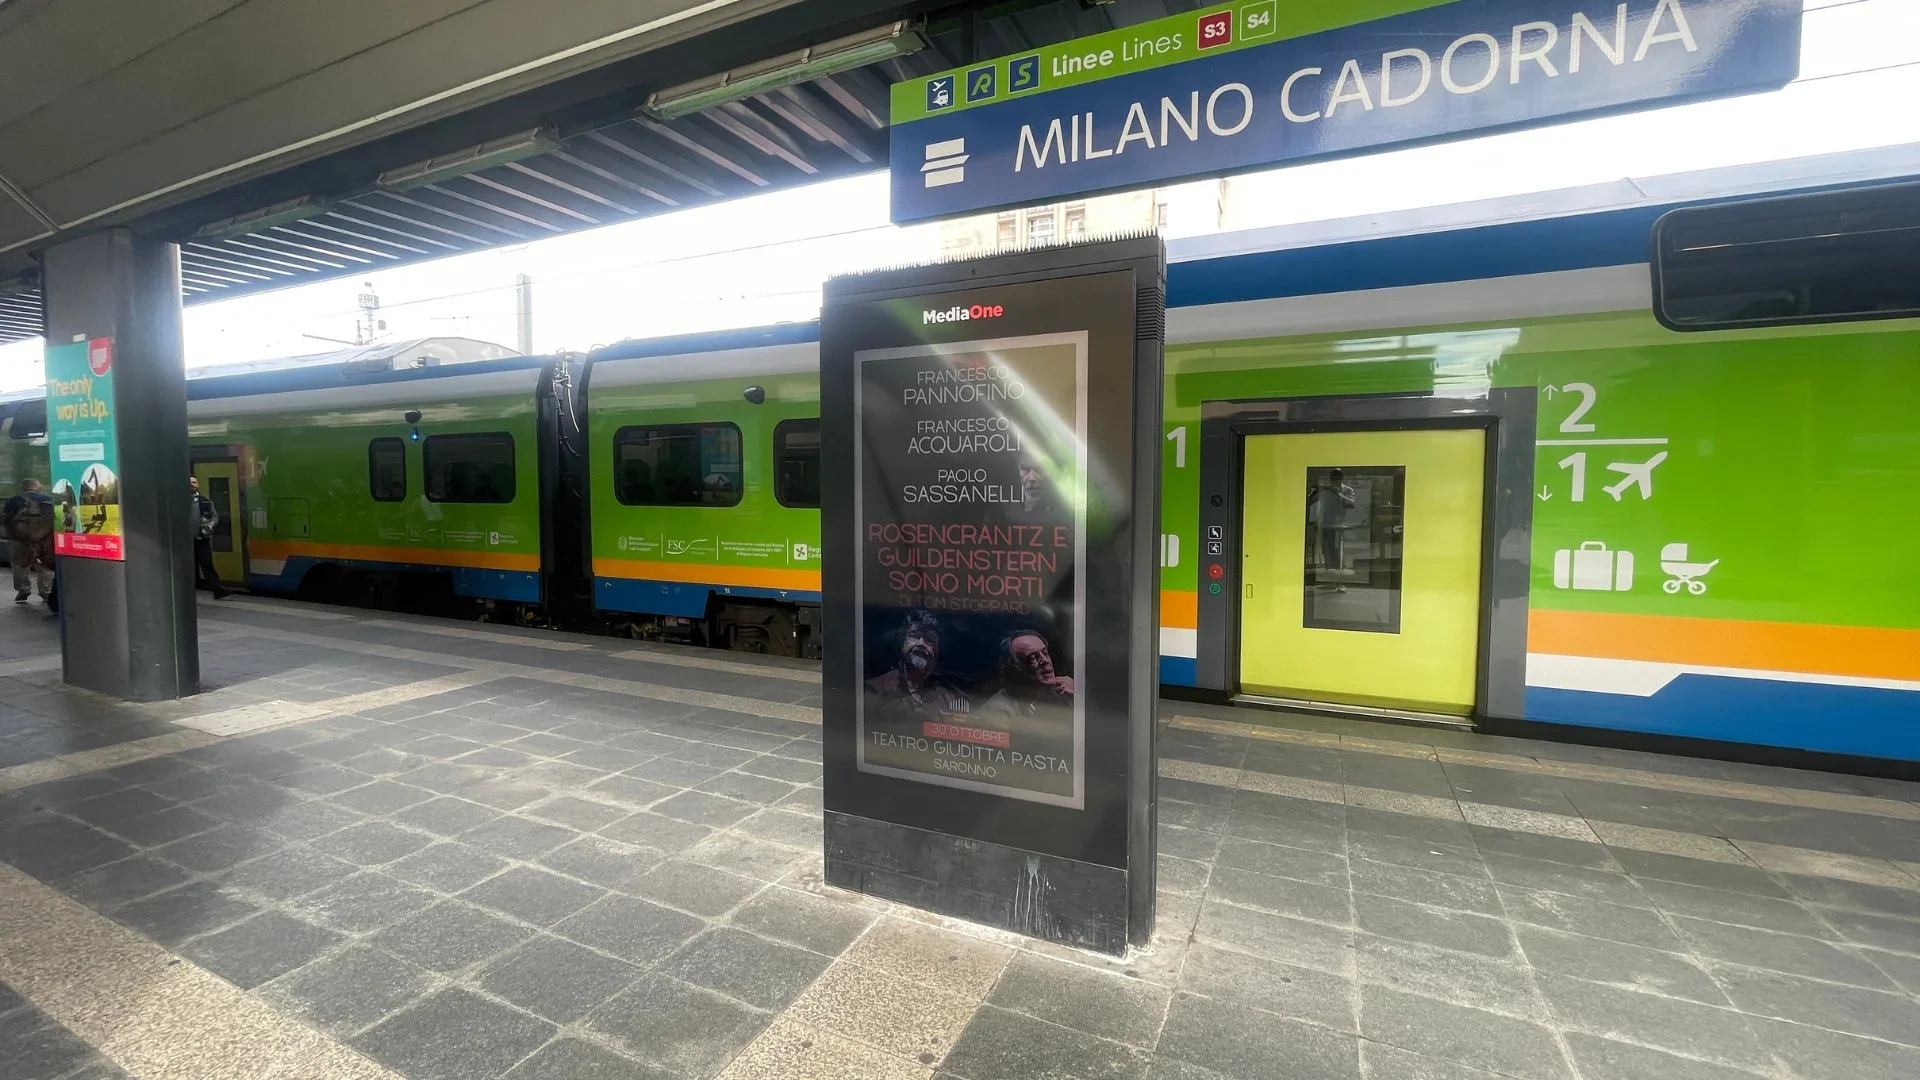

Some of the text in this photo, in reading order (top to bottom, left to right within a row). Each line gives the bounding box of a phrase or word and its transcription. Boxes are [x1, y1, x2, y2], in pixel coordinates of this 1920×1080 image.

[1052, 48, 1113, 77] Linee
[1122, 31, 1182, 62] Lines
[1204, 22, 1226, 38] S3
[1247, 11, 1270, 28] S4
[1014, 0, 1698, 172] MILANO CADORNA
[923, 304, 1003, 324] MediaOne
[70, 374, 93, 399] only
[917, 365, 1009, 384] FRANCESCO
[904, 381, 1024, 405] PANNOFINO
[56, 403, 78, 425] way
[1560, 382, 1596, 433] 2
[917, 416, 1009, 434] FRANCESCO
[908, 433, 1020, 454] ACQUAROLI
[1166, 426, 1186, 468] 1
[938, 468, 987, 483] PAOLO
[1558, 452, 1586, 502] 1
[903, 485, 1024, 503] SASSANELLI
[667, 540, 685, 551] FSC
[869, 523, 1068, 548] ROSENCRANTZ E
[878, 547, 1056, 572] GUILDENSTERN
[889, 570, 1043, 598] SONO MORTI
[931, 723, 1005, 743] 30 OTTOBRE
[871, 731, 1069, 773] TEATRO GIUDITTA PASTA
[933, 758, 997, 778] SARONNO
